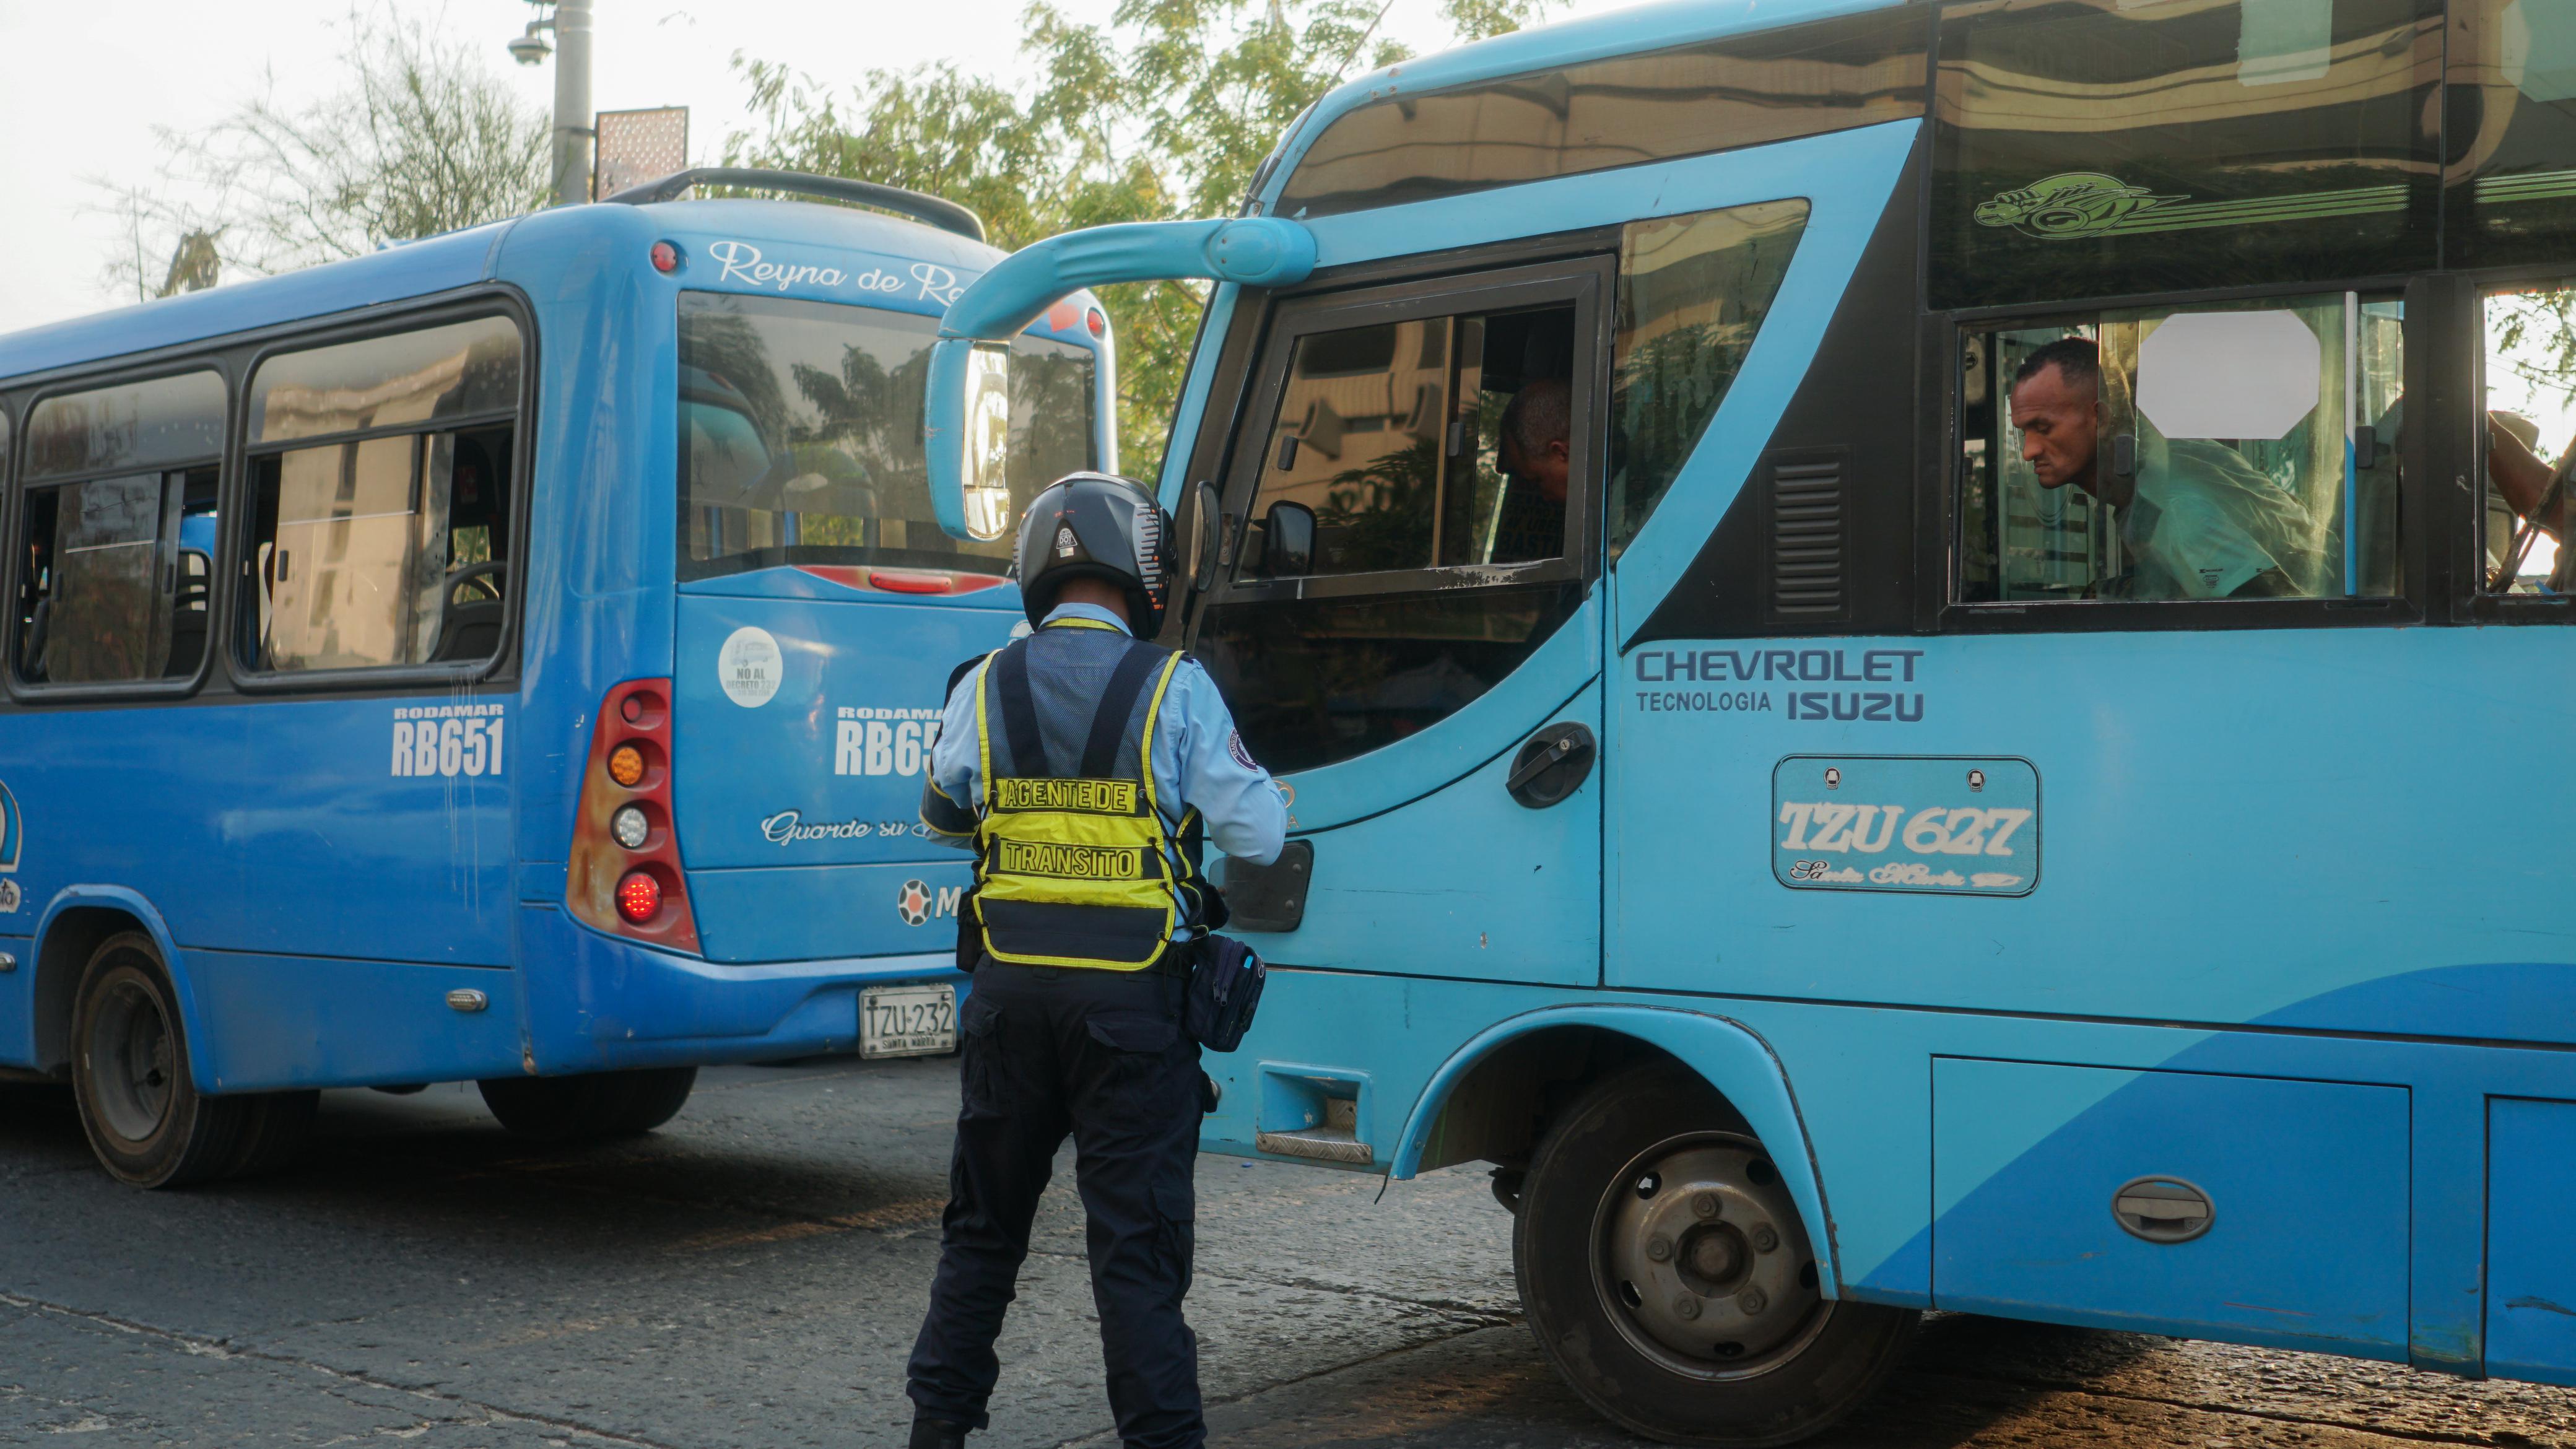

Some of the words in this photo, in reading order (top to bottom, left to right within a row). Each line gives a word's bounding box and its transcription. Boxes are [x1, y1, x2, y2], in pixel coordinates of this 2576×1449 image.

[710, 241, 848, 292] Reyna
[858, 269, 906, 293] de
[1060, 535, 1072, 544] DOT
[737, 668, 751, 679] NO
[754, 668, 765, 679] AL
[1636, 650, 1925, 682] CHEVROLET
[726, 680, 759, 689] DECRETO
[394, 704, 504, 720] RODAMAR
[1636, 691, 1772, 712] TECNOLOGIA
[1787, 691, 1924, 722] ISUZU
[391, 718, 503, 777] RB651
[1005, 780, 1092, 809] AGENTE
[1095, 781, 1128, 812] DE
[761, 809, 874, 846] Guarde
[879, 820, 908, 837] su
[1779, 801, 1905, 853] TZU
[1902, 806, 2033, 856] 627
[1006, 843, 1135, 877] TRANSITO
[883, 1038, 907, 1050] SANTA
